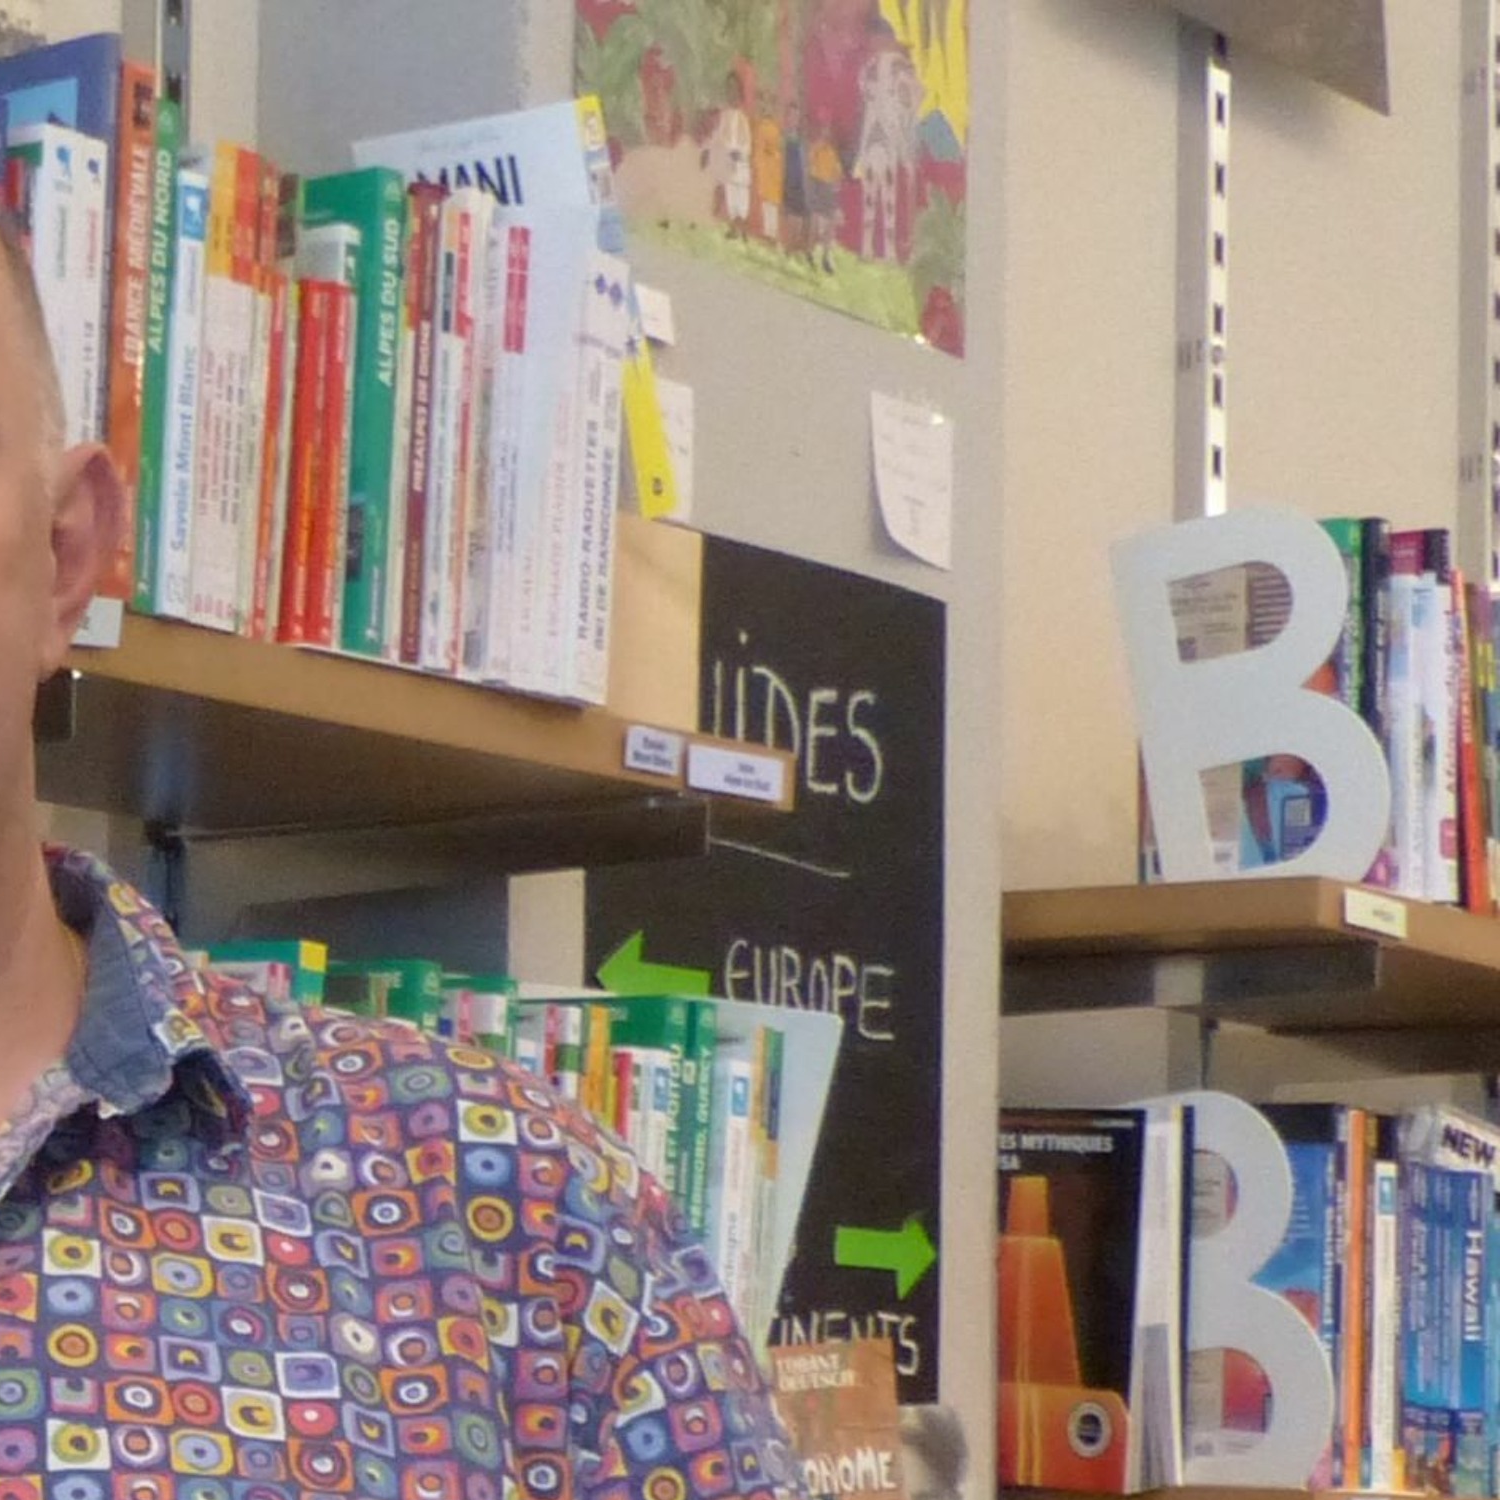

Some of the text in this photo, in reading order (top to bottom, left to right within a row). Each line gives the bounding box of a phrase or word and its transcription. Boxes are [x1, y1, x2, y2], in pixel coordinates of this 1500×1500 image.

[148, 149, 174, 353] ALPES DU NORD
[376, 219, 401, 388] ALPES DU SUD
[171, 345, 198, 553] Savoie Mont Blanc
[1110, 506, 1391, 884] B
[725, 939, 895, 1041] EUROPE
[1021, 1134, 1114, 1154] MYTHIQUES
[1442, 1124, 1497, 1167] NEW
[1184, 1090, 1336, 1490] B
[1465, 1230, 1484, 1341] Hawaii
